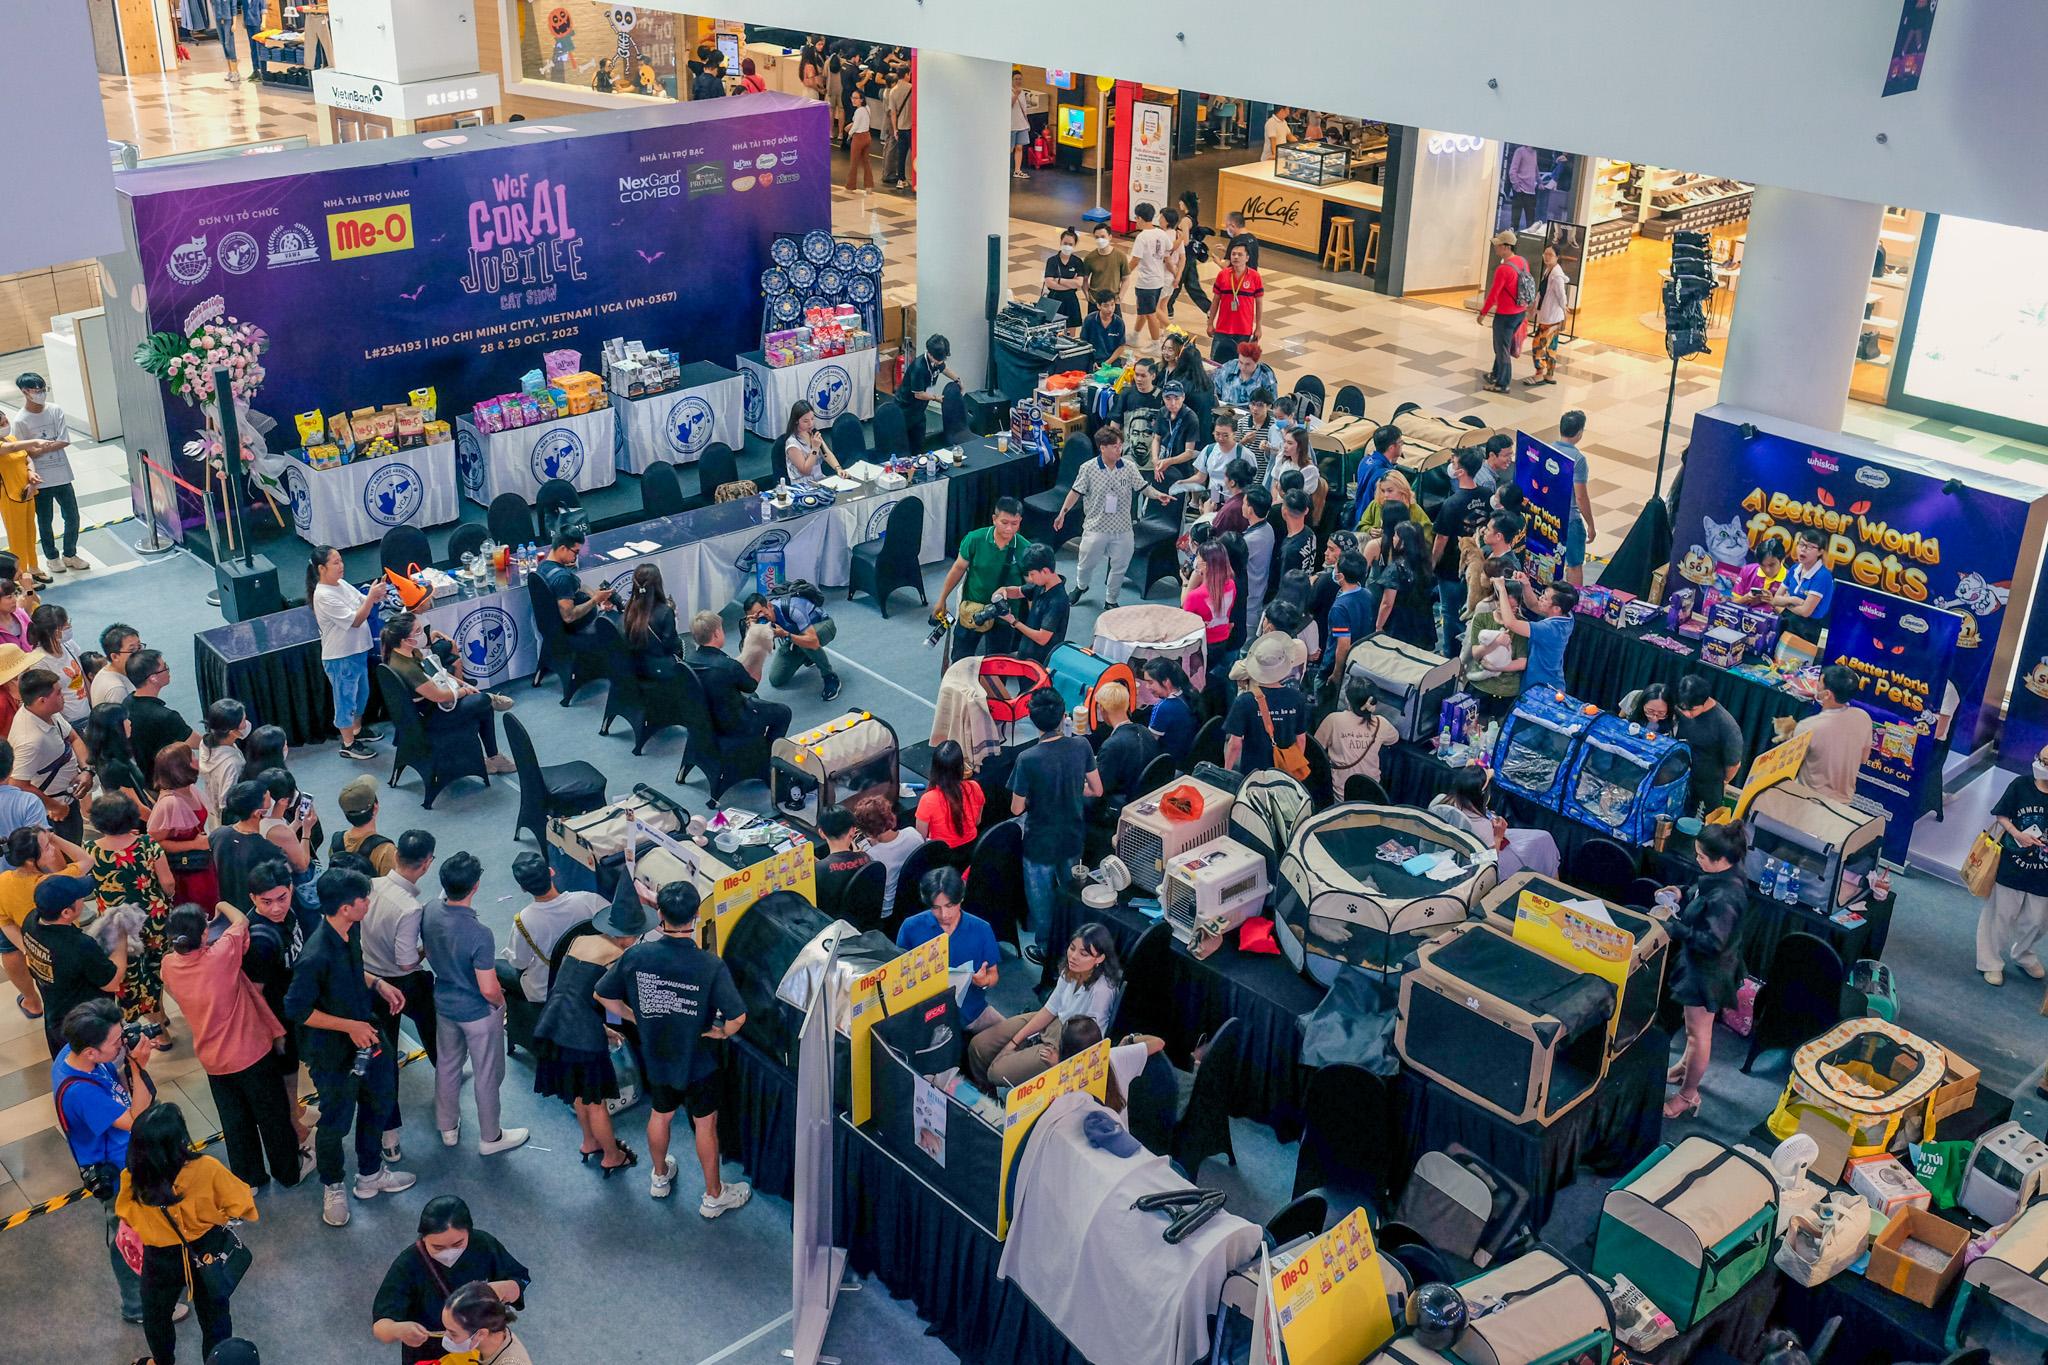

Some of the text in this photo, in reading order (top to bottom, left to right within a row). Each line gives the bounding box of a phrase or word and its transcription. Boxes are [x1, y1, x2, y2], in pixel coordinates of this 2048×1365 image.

[332, 86, 374, 106] VietinBank
[426, 88, 478, 106] RISIS
[640, 148, 704, 163] NHÀ TÀI TRỢ BẠC
[492, 173, 529, 202] WCF
[620, 170, 680, 191] NexGard
[324, 190, 410, 208] NHÀ TÀI TRỢ VÀNG
[620, 185, 680, 203] COMBO
[198, 207, 280, 226] ĐƠN VỊ TỔ CHỨC
[468, 179, 576, 252] CORAL
[1242, 196, 1300, 226] McCafé
[336, 214, 406, 251] Me-O
[172, 251, 203, 262] WCF
[460, 238, 588, 293] JUBILEE
[500, 284, 557, 310] CAT SHOW
[365, 340, 422, 360] L#234193
[432, 336, 450, 347] HO
[452, 330, 473, 342] CHI
[476, 324, 507, 338] MINH
[510, 318, 538, 332] CITY,
[542, 308, 592, 325] VIETNAM
[601, 302, 624, 314] VCA
[626, 290, 677, 310] (VN-0367)
[480, 344, 494, 354] 28
[497, 341, 504, 350] &
[508, 338, 520, 348] 29
[552, 326, 579, 340] 2023
[1807, 456, 1840, 472] whiskas
[397, 496, 408, 510] VCA
[1534, 514, 1558, 544] Pets
[1741, 487, 1940, 564] A Better World
[1704, 566, 1709, 574] 1
[1826, 534, 1928, 600] Pets
[1858, 604, 1886, 618] whiskas
[490, 643, 502, 658] VCA
[1834, 654, 1848, 666] A
[1848, 656, 1890, 678] Better
[1890, 670, 1930, 694] World
[1874, 678, 1924, 712] Pets
[1883, 766, 1894, 775] OF
[1896, 771, 1912, 782] CAT
[723, 871, 752, 891] Me-O
[860, 968, 887, 992] Me-O
[1016, 1076, 1046, 1101] Me-O
[1928, 1152, 1944, 1166] TÚI
[1281, 1258, 1308, 1292] Me-O
[1627, 1292, 1645, 1306] TOFU
